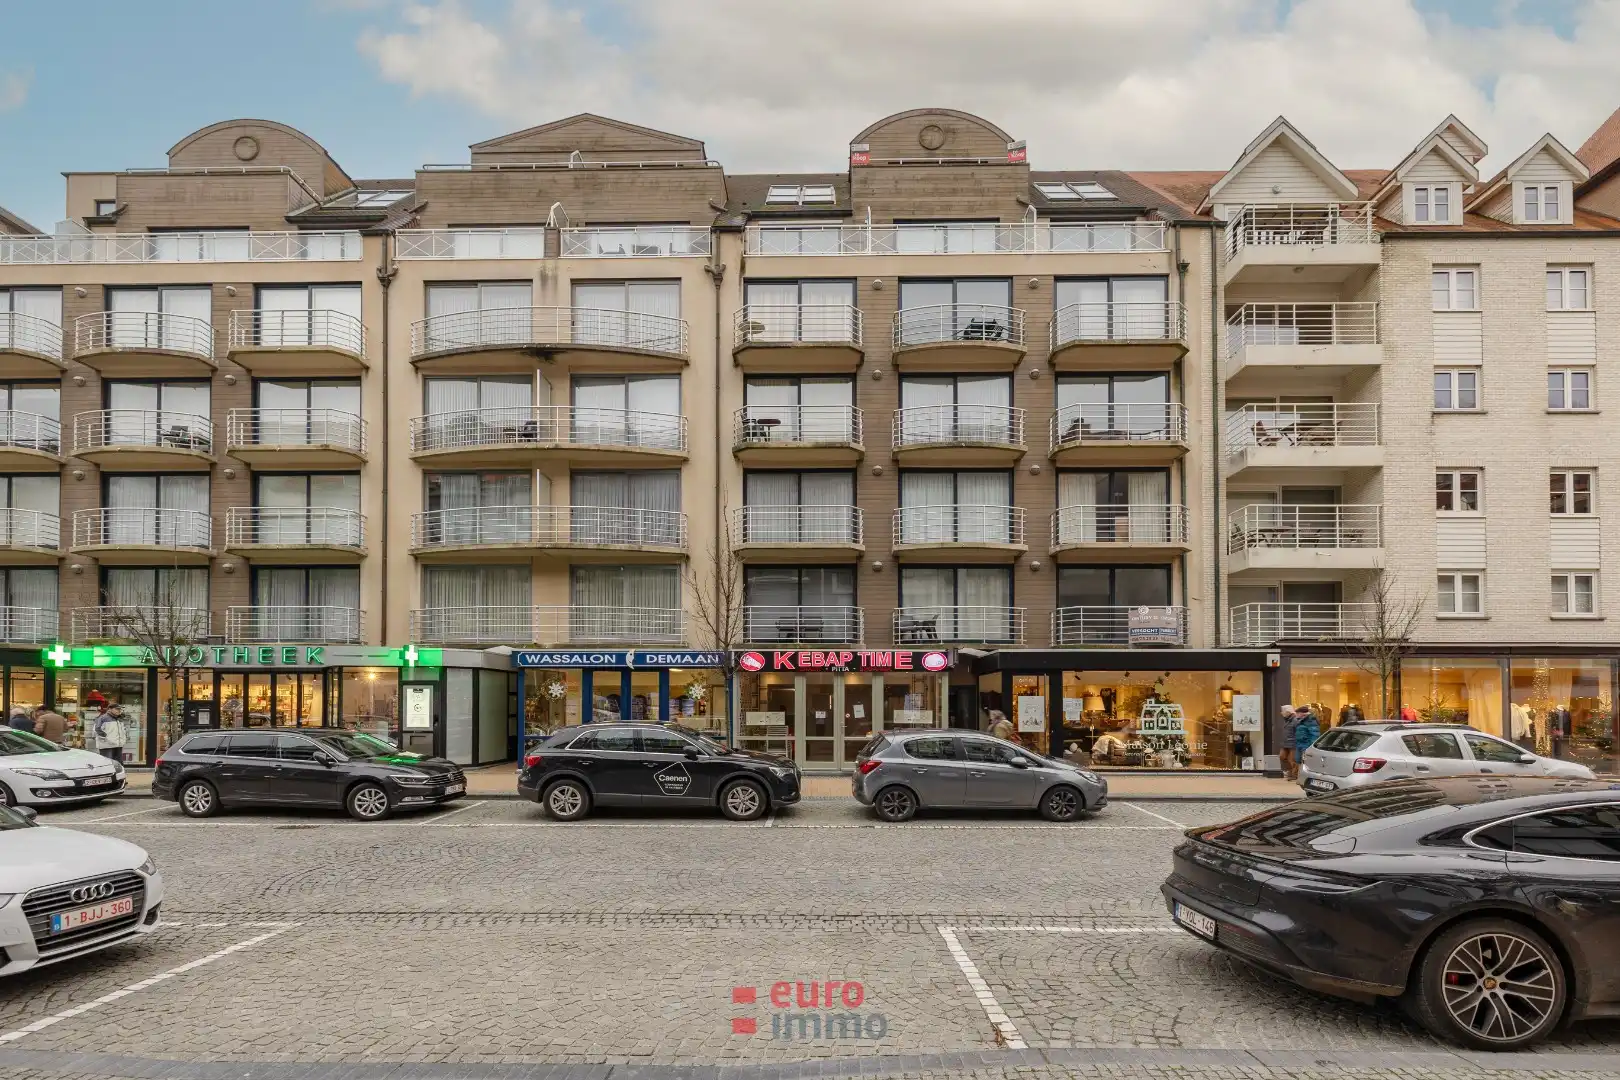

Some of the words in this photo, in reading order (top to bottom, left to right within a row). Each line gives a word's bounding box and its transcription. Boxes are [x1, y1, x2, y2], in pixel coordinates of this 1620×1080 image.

[141, 646, 325, 665] APOTHEEK
[525, 654, 616, 664] WASSALON
[646, 654, 719, 664] DEMAAN
[773, 651, 854, 670] KEBAP
[857, 651, 913, 670] TIME
[658, 774, 688, 782] Caenen
[65, 900, 131, 926] 1-BJJ-360
